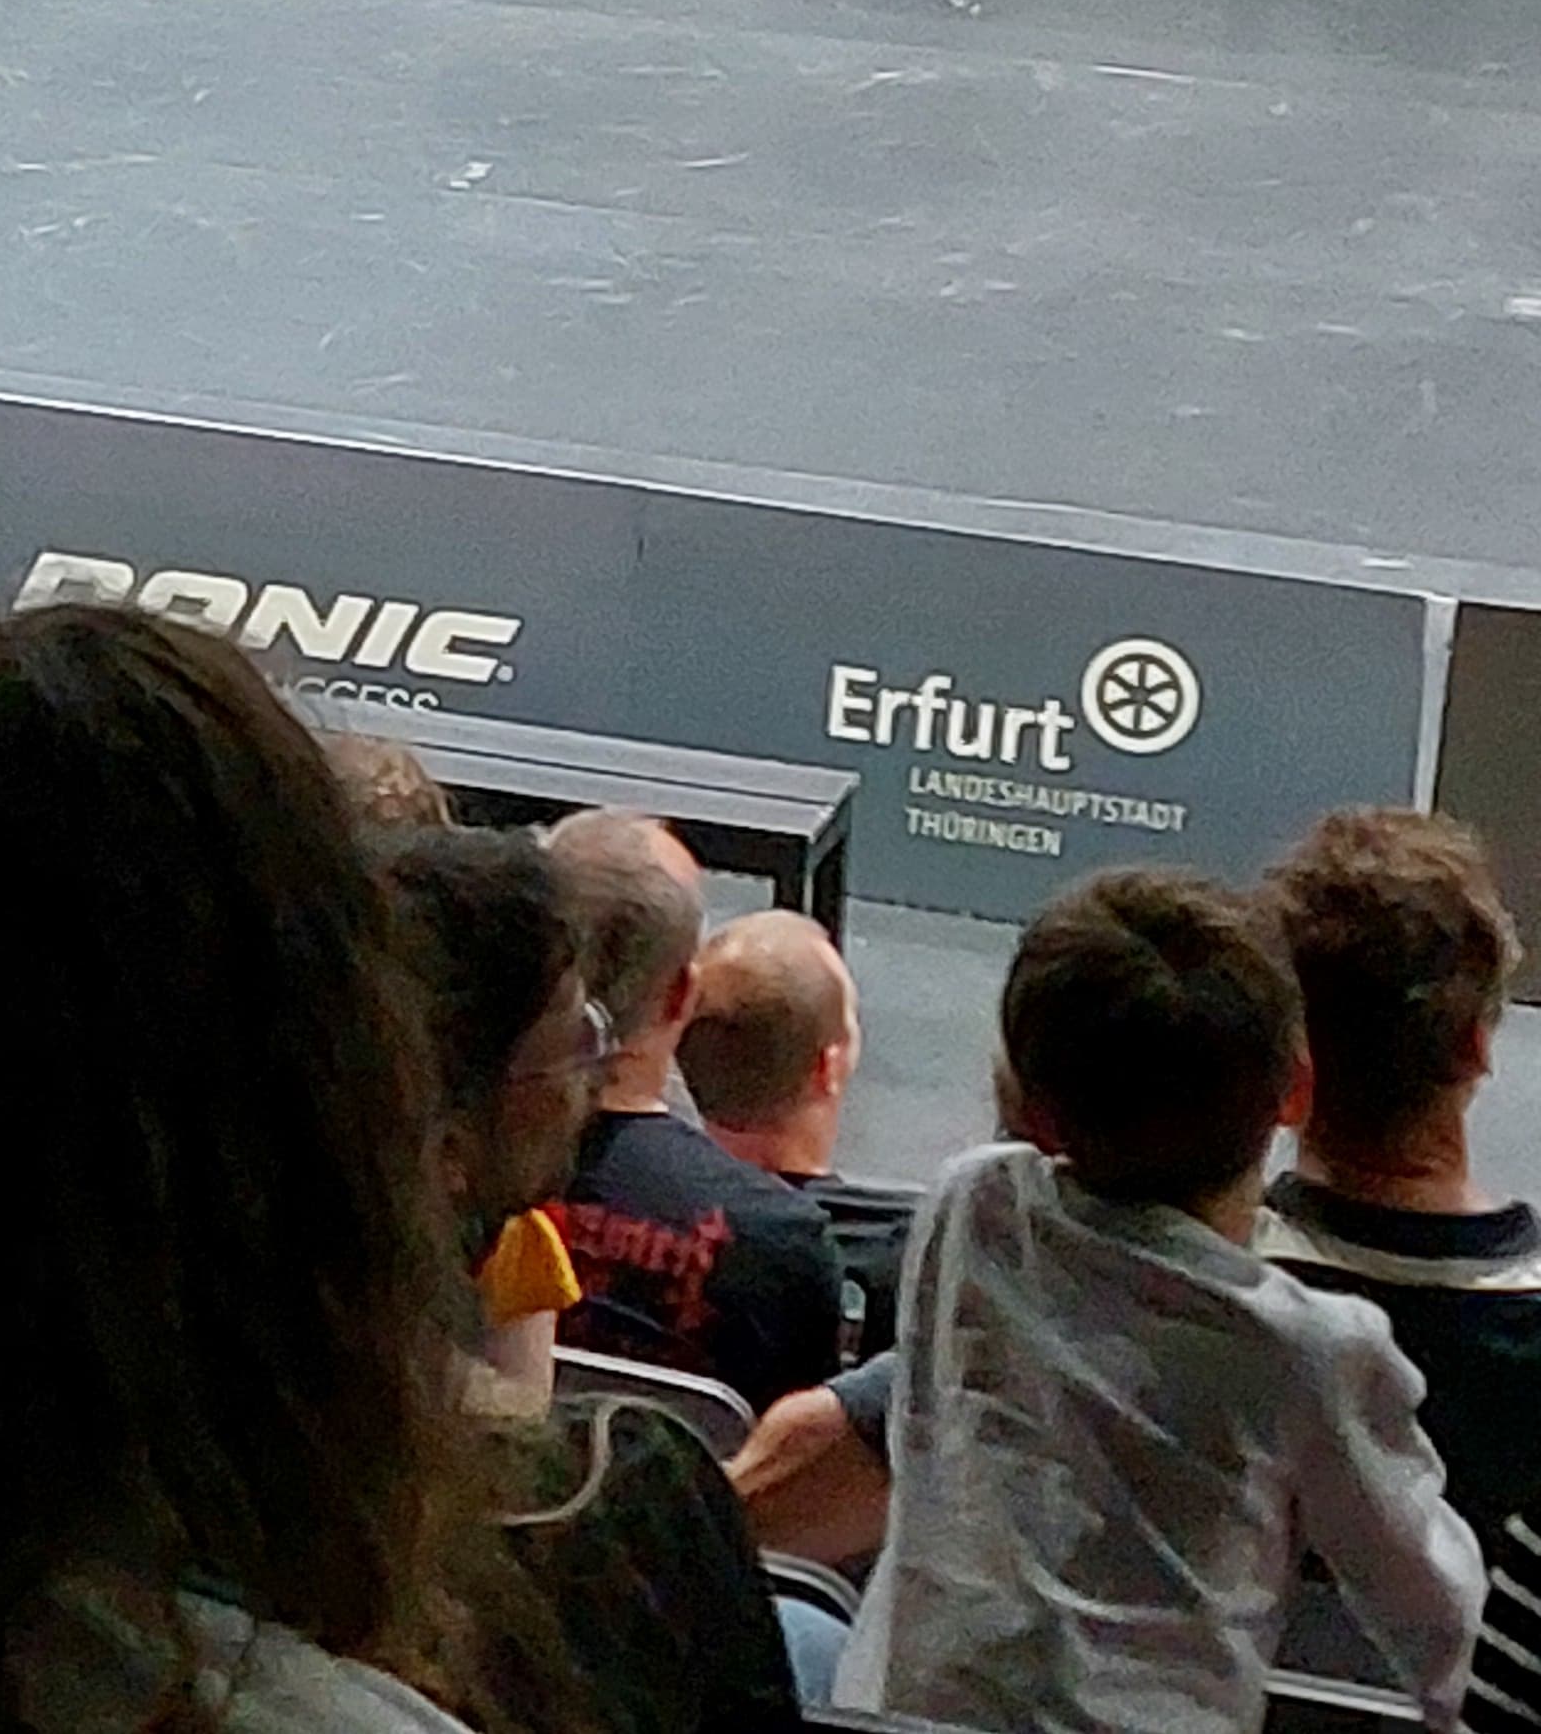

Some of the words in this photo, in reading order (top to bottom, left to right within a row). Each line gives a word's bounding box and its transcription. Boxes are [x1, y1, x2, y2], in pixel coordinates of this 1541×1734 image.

[828, 664, 1075, 771] Erfurt
[905, 807, 1063, 857] THÜRINGEN
[910, 767, 1187, 832] LANDESHAUPTSTADT
